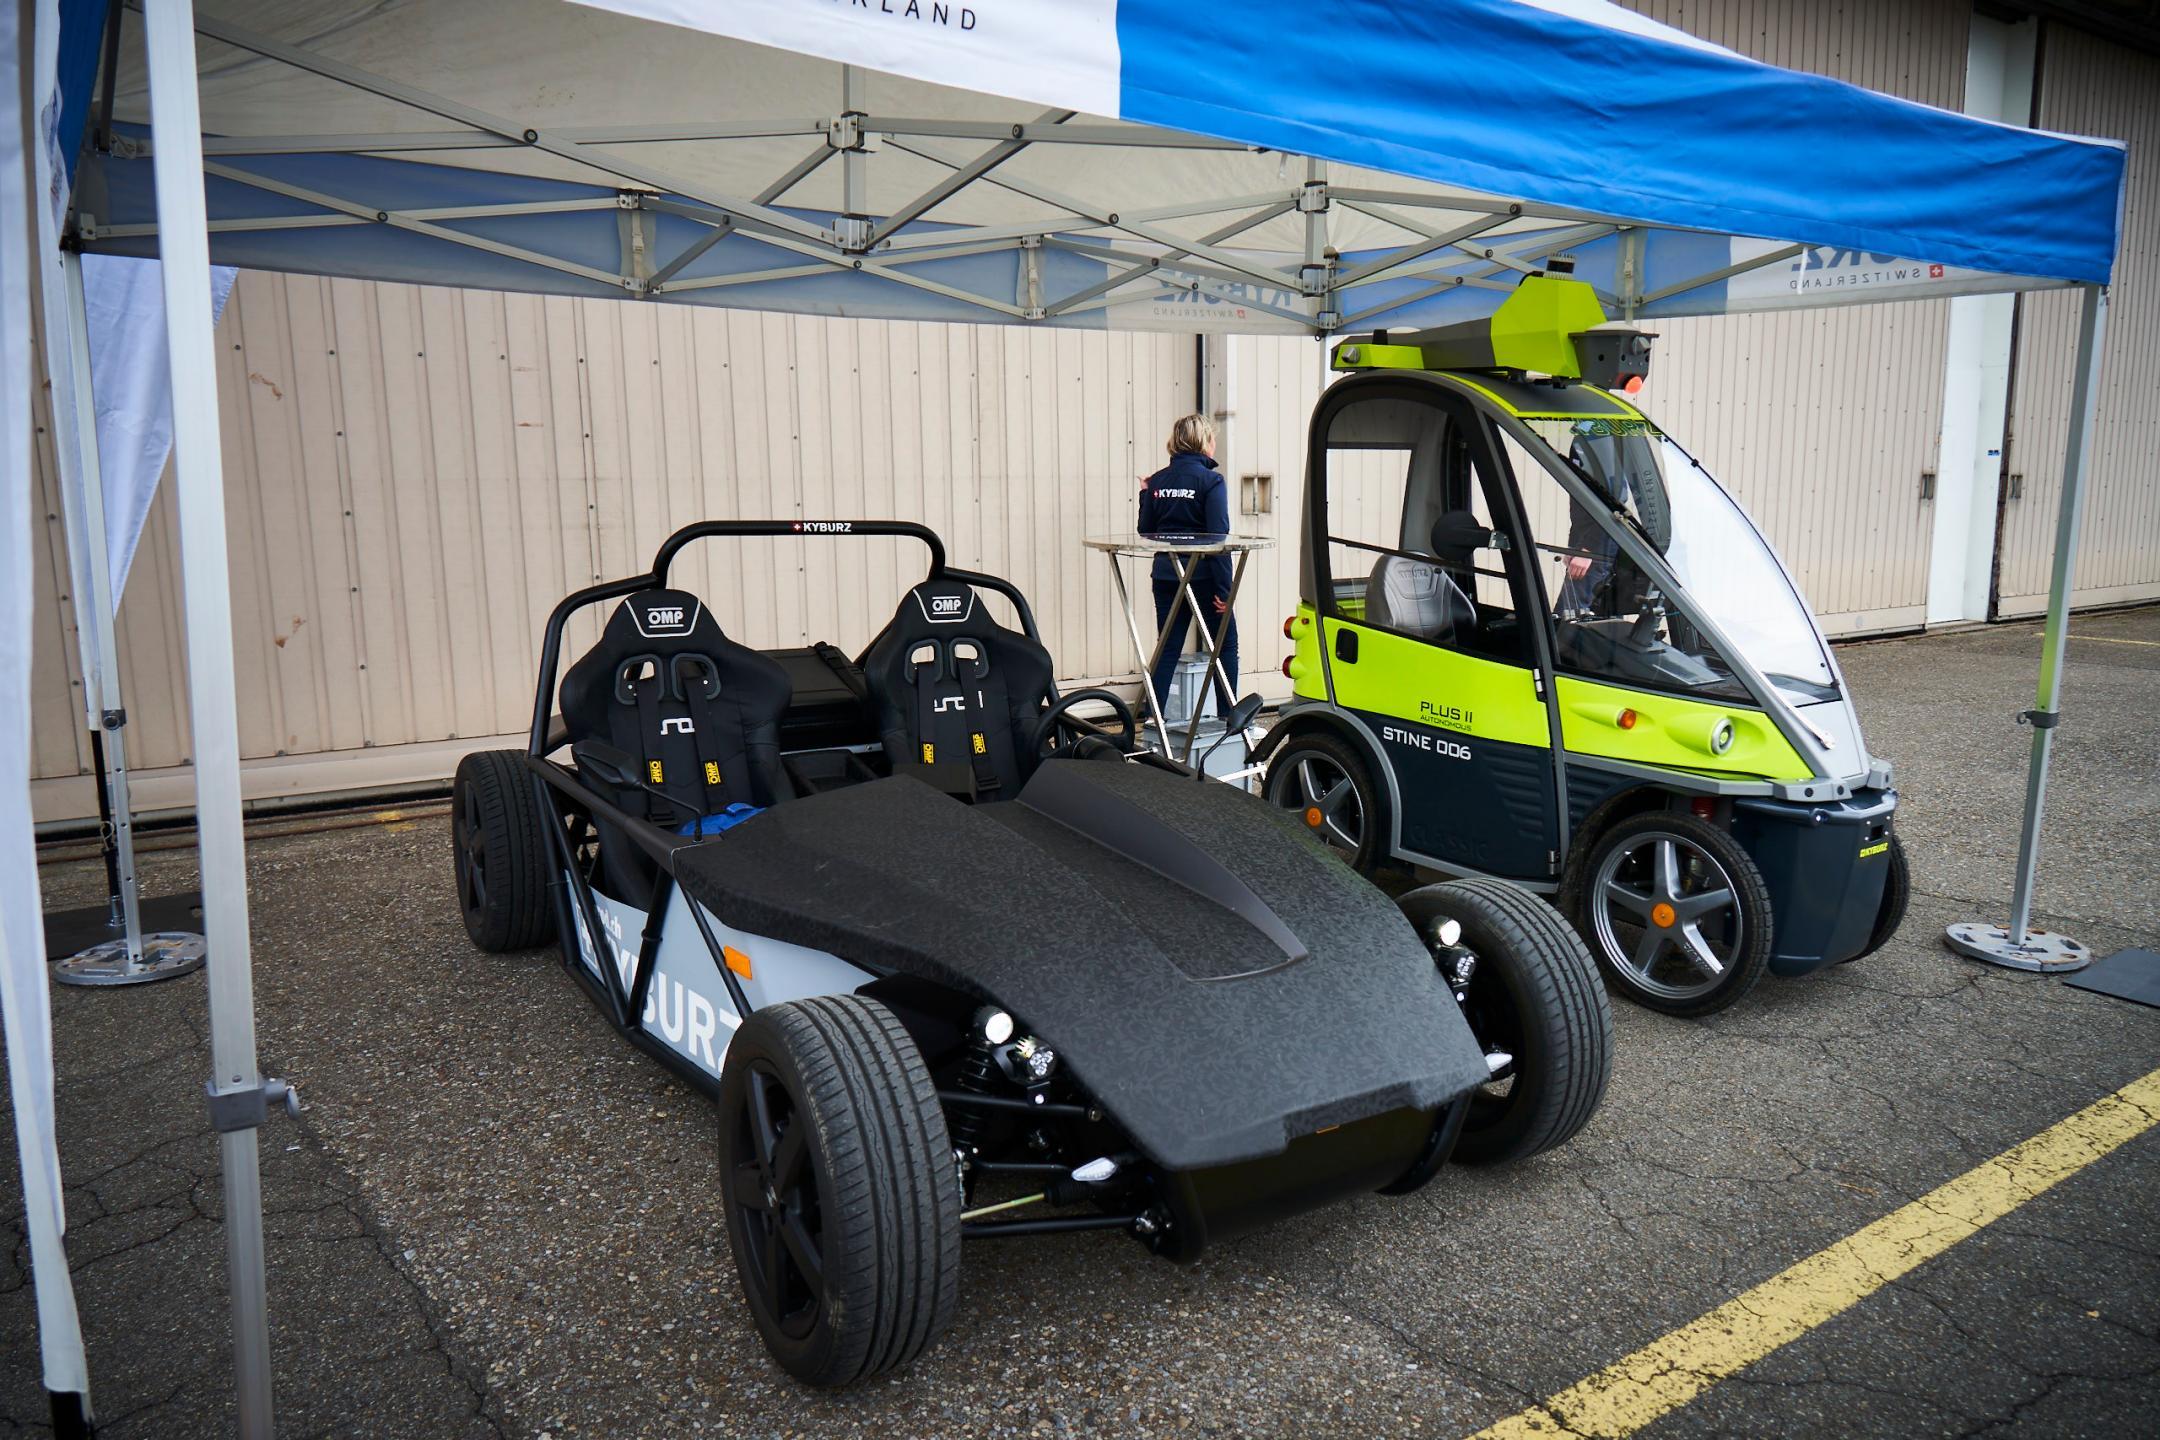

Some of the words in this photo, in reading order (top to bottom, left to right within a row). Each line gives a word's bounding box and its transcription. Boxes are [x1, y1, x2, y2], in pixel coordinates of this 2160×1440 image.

[1159, 488, 1196, 499] KYBURZ
[803, 522, 852, 532] KYBURZ
[932, 599, 962, 612] OMP
[648, 611, 684, 625] OMP
[1420, 701, 1460, 721] PLUS
[1465, 711, 1473, 723] II
[1420, 714, 1473, 732] AUTONOMOUS
[973, 733, 986, 754] OMP
[1383, 726, 1432, 751] STINE
[1436, 739, 1472, 760] 006
[924, 744, 935, 764] OMP
[649, 761, 663, 783] OMP
[704, 763, 721, 785] OMP
